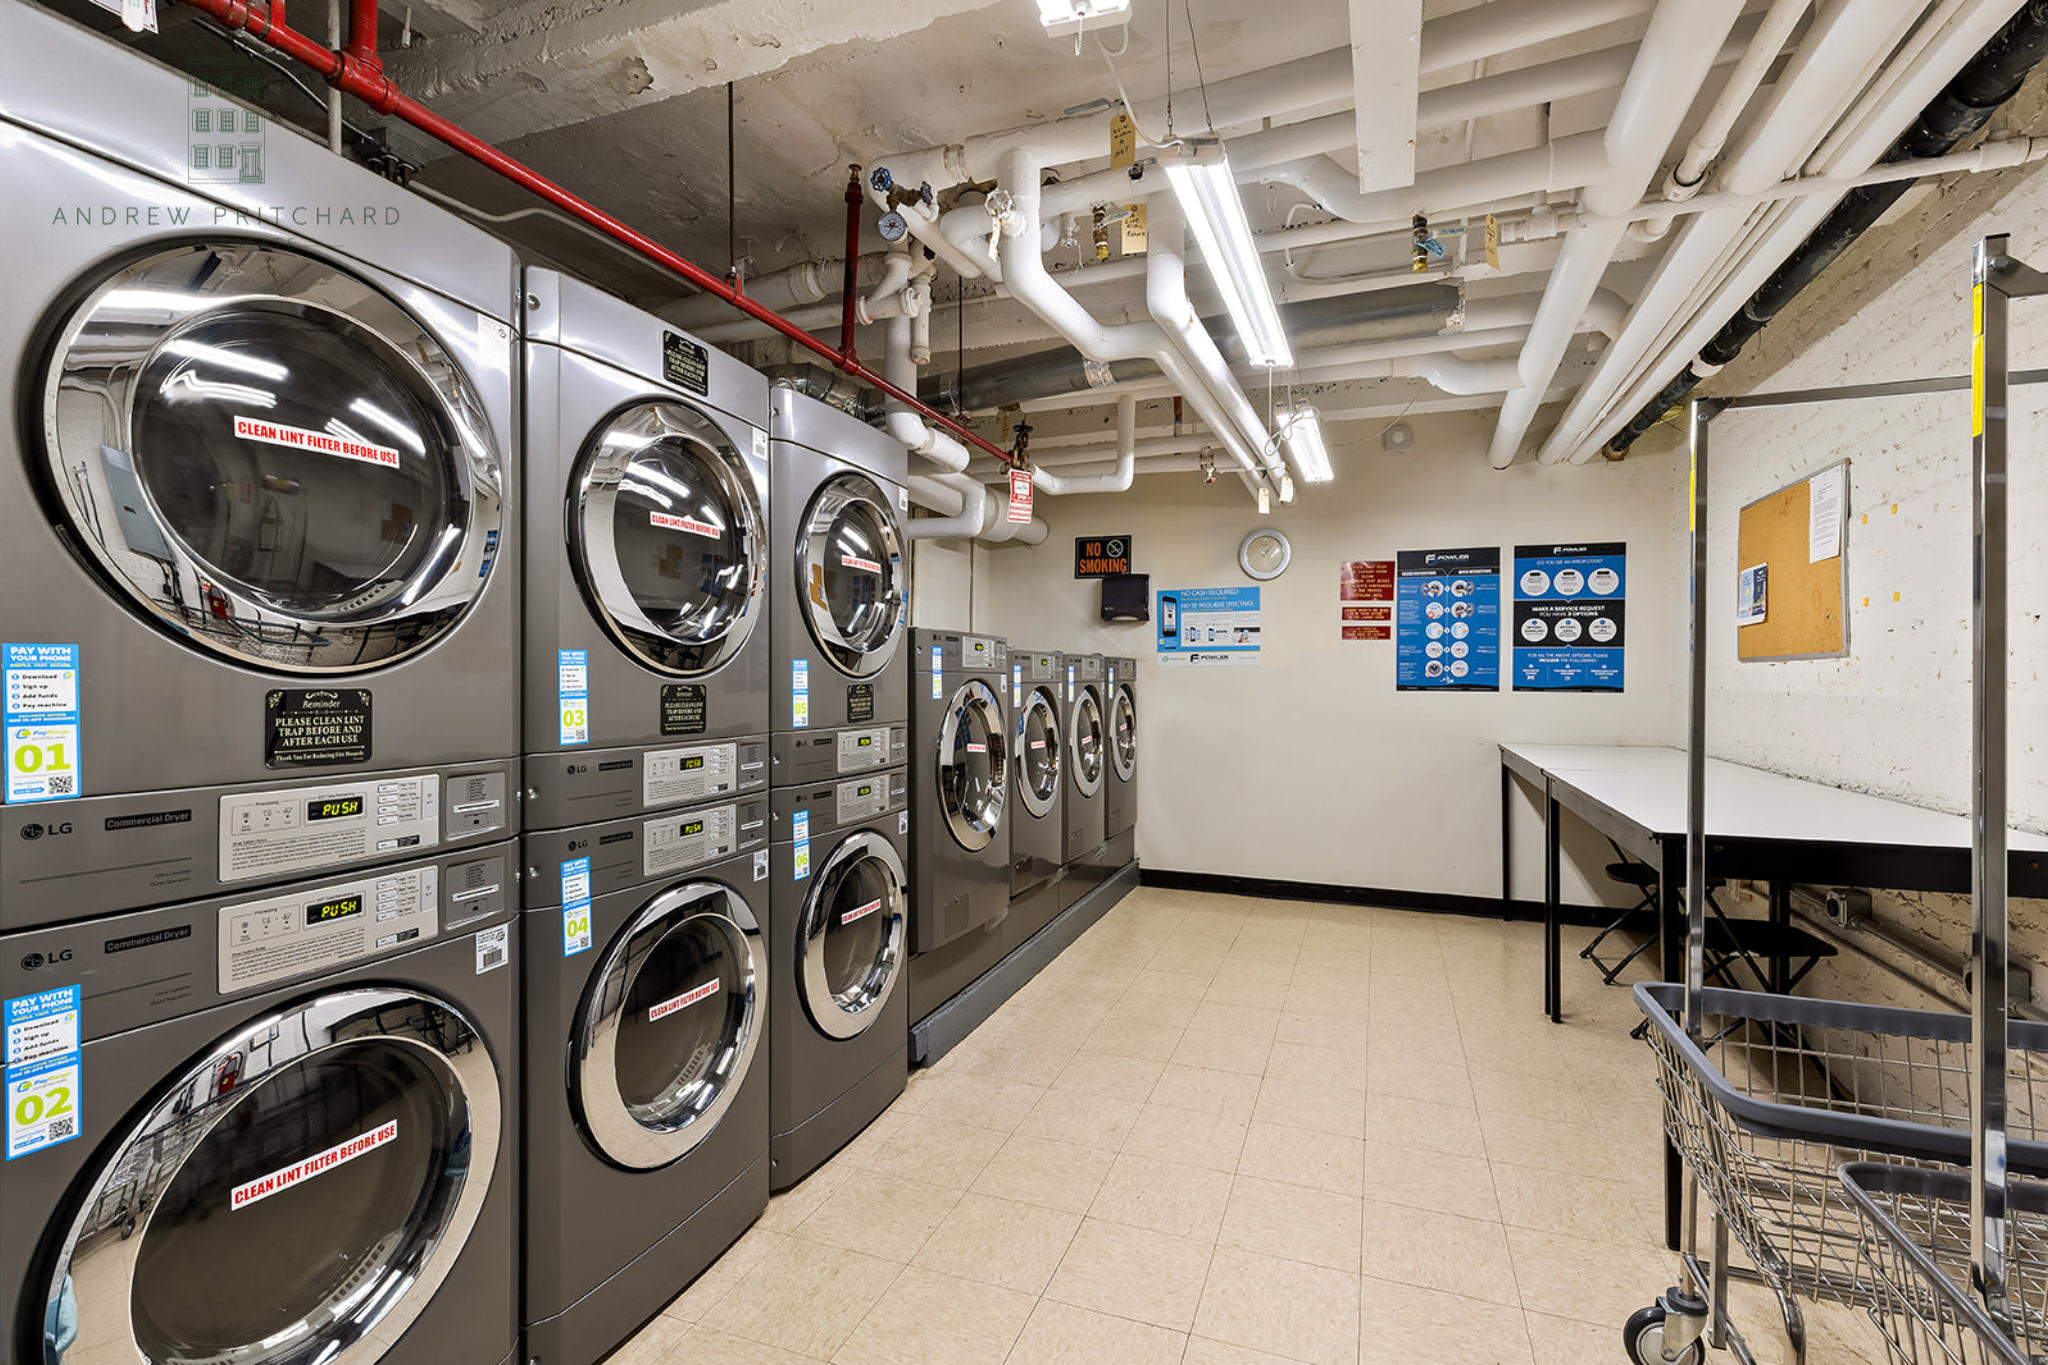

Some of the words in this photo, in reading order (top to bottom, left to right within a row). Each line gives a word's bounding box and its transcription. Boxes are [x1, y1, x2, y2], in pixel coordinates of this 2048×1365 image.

[238, 421, 276, 440] CLEAN
[280, 429, 305, 445] LINT
[307, 435, 341, 453] FILTER
[343, 442, 378, 460] BEFORE
[380, 451, 398, 464] USE
[1086, 542, 1102, 557] NO
[1079, 557, 1127, 574] SMOKING
[10, 647, 35, 655] PAY
[37, 647, 71, 655] WITH
[302, 700, 341, 708] Reminder
[794, 702, 807, 715] 05
[275, 717, 311, 727] PLEASE
[313, 717, 343, 725] CLEAN
[344, 715, 365, 724] LINT
[563, 709, 585, 727] 03
[278, 727, 304, 737] TRAP
[306, 726, 341, 735] BEFORE
[342, 725, 362, 733] AND
[282, 737, 313, 747] AFTER
[314, 735, 340, 745] EACH
[341, 735, 359, 743] USE
[14, 743, 71, 773] 01
[577, 764, 588, 773] LG
[322, 801, 358, 816] PUSH
[106, 815, 162, 829] Commercial
[164, 812, 190, 823] Dryer
[48, 822, 73, 836] LG
[578, 840, 589, 849] LG
[796, 852, 808, 867] 06
[321, 900, 357, 918] PUSH
[566, 916, 589, 938] 04
[106, 932, 162, 951] Commercial
[164, 928, 190, 940] Dryer
[48, 949, 73, 964] LG
[12, 997, 37, 1010] PAY
[39, 988, 73, 1003] WITH
[12, 1005, 39, 1016] YOUR
[41, 997, 73, 1010] PHONE
[651, 1004, 668, 1019] CLEAN
[15, 1086, 72, 1126] 02
[234, 1178, 274, 1205] CLEAN
[276, 1166, 302, 1188] LINT
[304, 1151, 338, 1176] FILTER
[340, 1134, 376, 1160] BEFORE
[377, 1124, 395, 1142] USE
